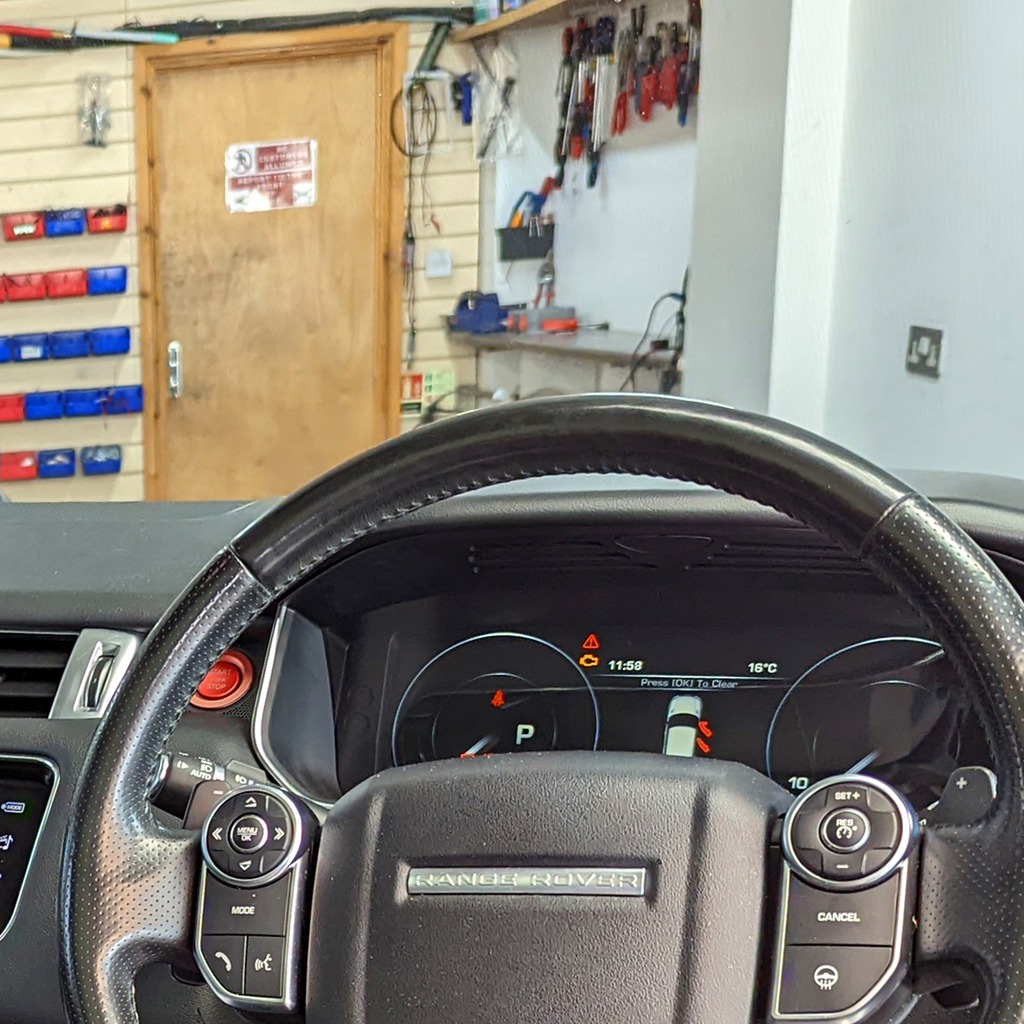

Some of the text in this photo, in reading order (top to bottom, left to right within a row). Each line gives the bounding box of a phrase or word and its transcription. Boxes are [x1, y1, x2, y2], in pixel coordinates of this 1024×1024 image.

[608, 660, 643, 671] 11:58
[748, 662, 778, 673] 16°C
[206, 683, 226, 691] STOP
[640, 678, 669, 687] Press
[697, 679, 709, 688] To
[711, 679, 738, 688] Clear
[516, 724, 535, 745] P
[190, 769, 212, 781] AUTO
[788, 776, 809, 790] 10
[835, 818, 854, 826] RES
[237, 826, 258, 834] MENU
[414, 872, 639, 888] RANGE ROVER
[231, 905, 256, 915] MODE
[817, 912, 861, 922] CANCEL
